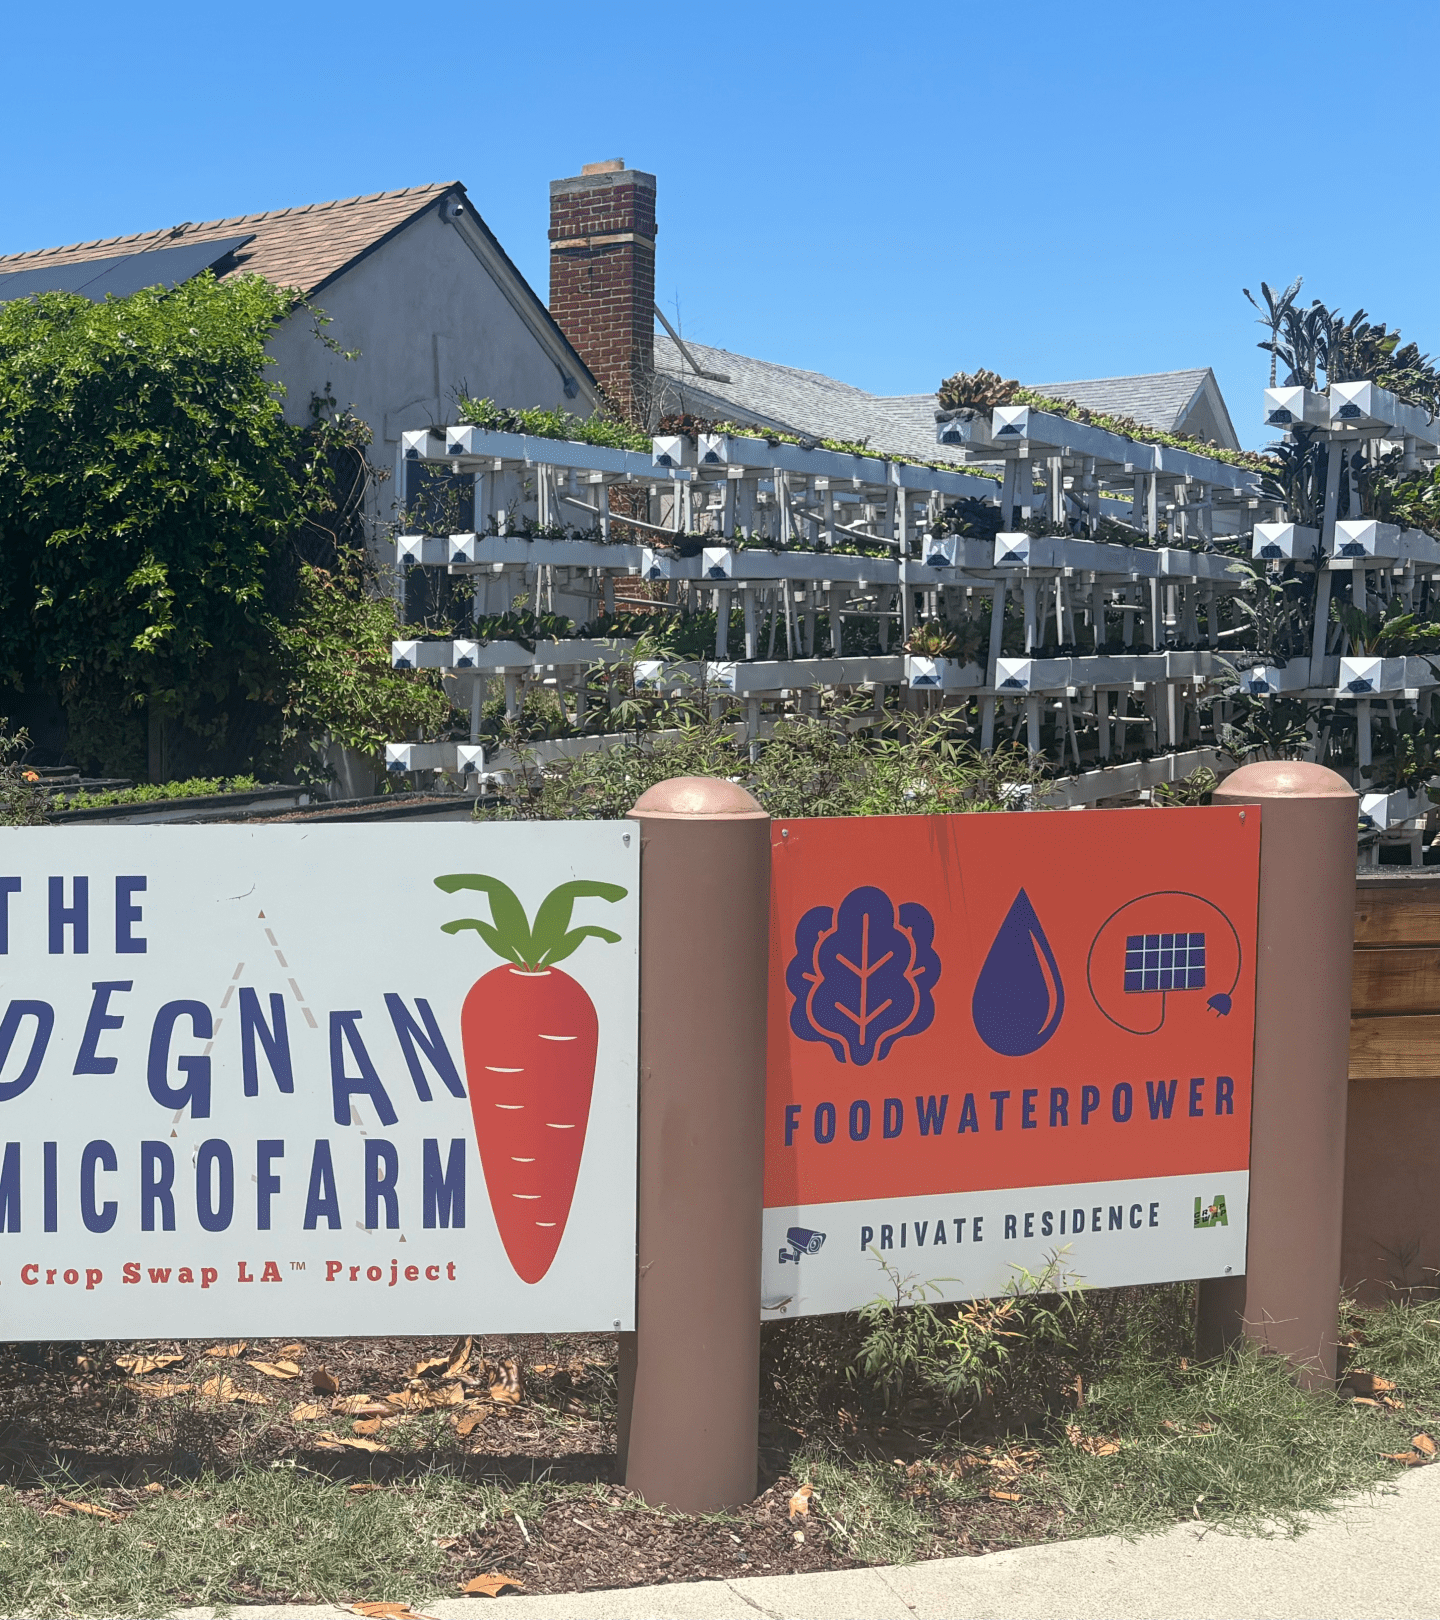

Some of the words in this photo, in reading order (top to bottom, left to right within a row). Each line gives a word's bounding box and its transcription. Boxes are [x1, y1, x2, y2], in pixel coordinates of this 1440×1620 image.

[861, 1217, 984, 1251] PRIVATE
[1004, 1202, 1160, 1239] RESIDENCE
[21, 1263, 104, 1289] Crop
[122, 1262, 218, 1287] Swap
[326, 1260, 457, 1287] Project
